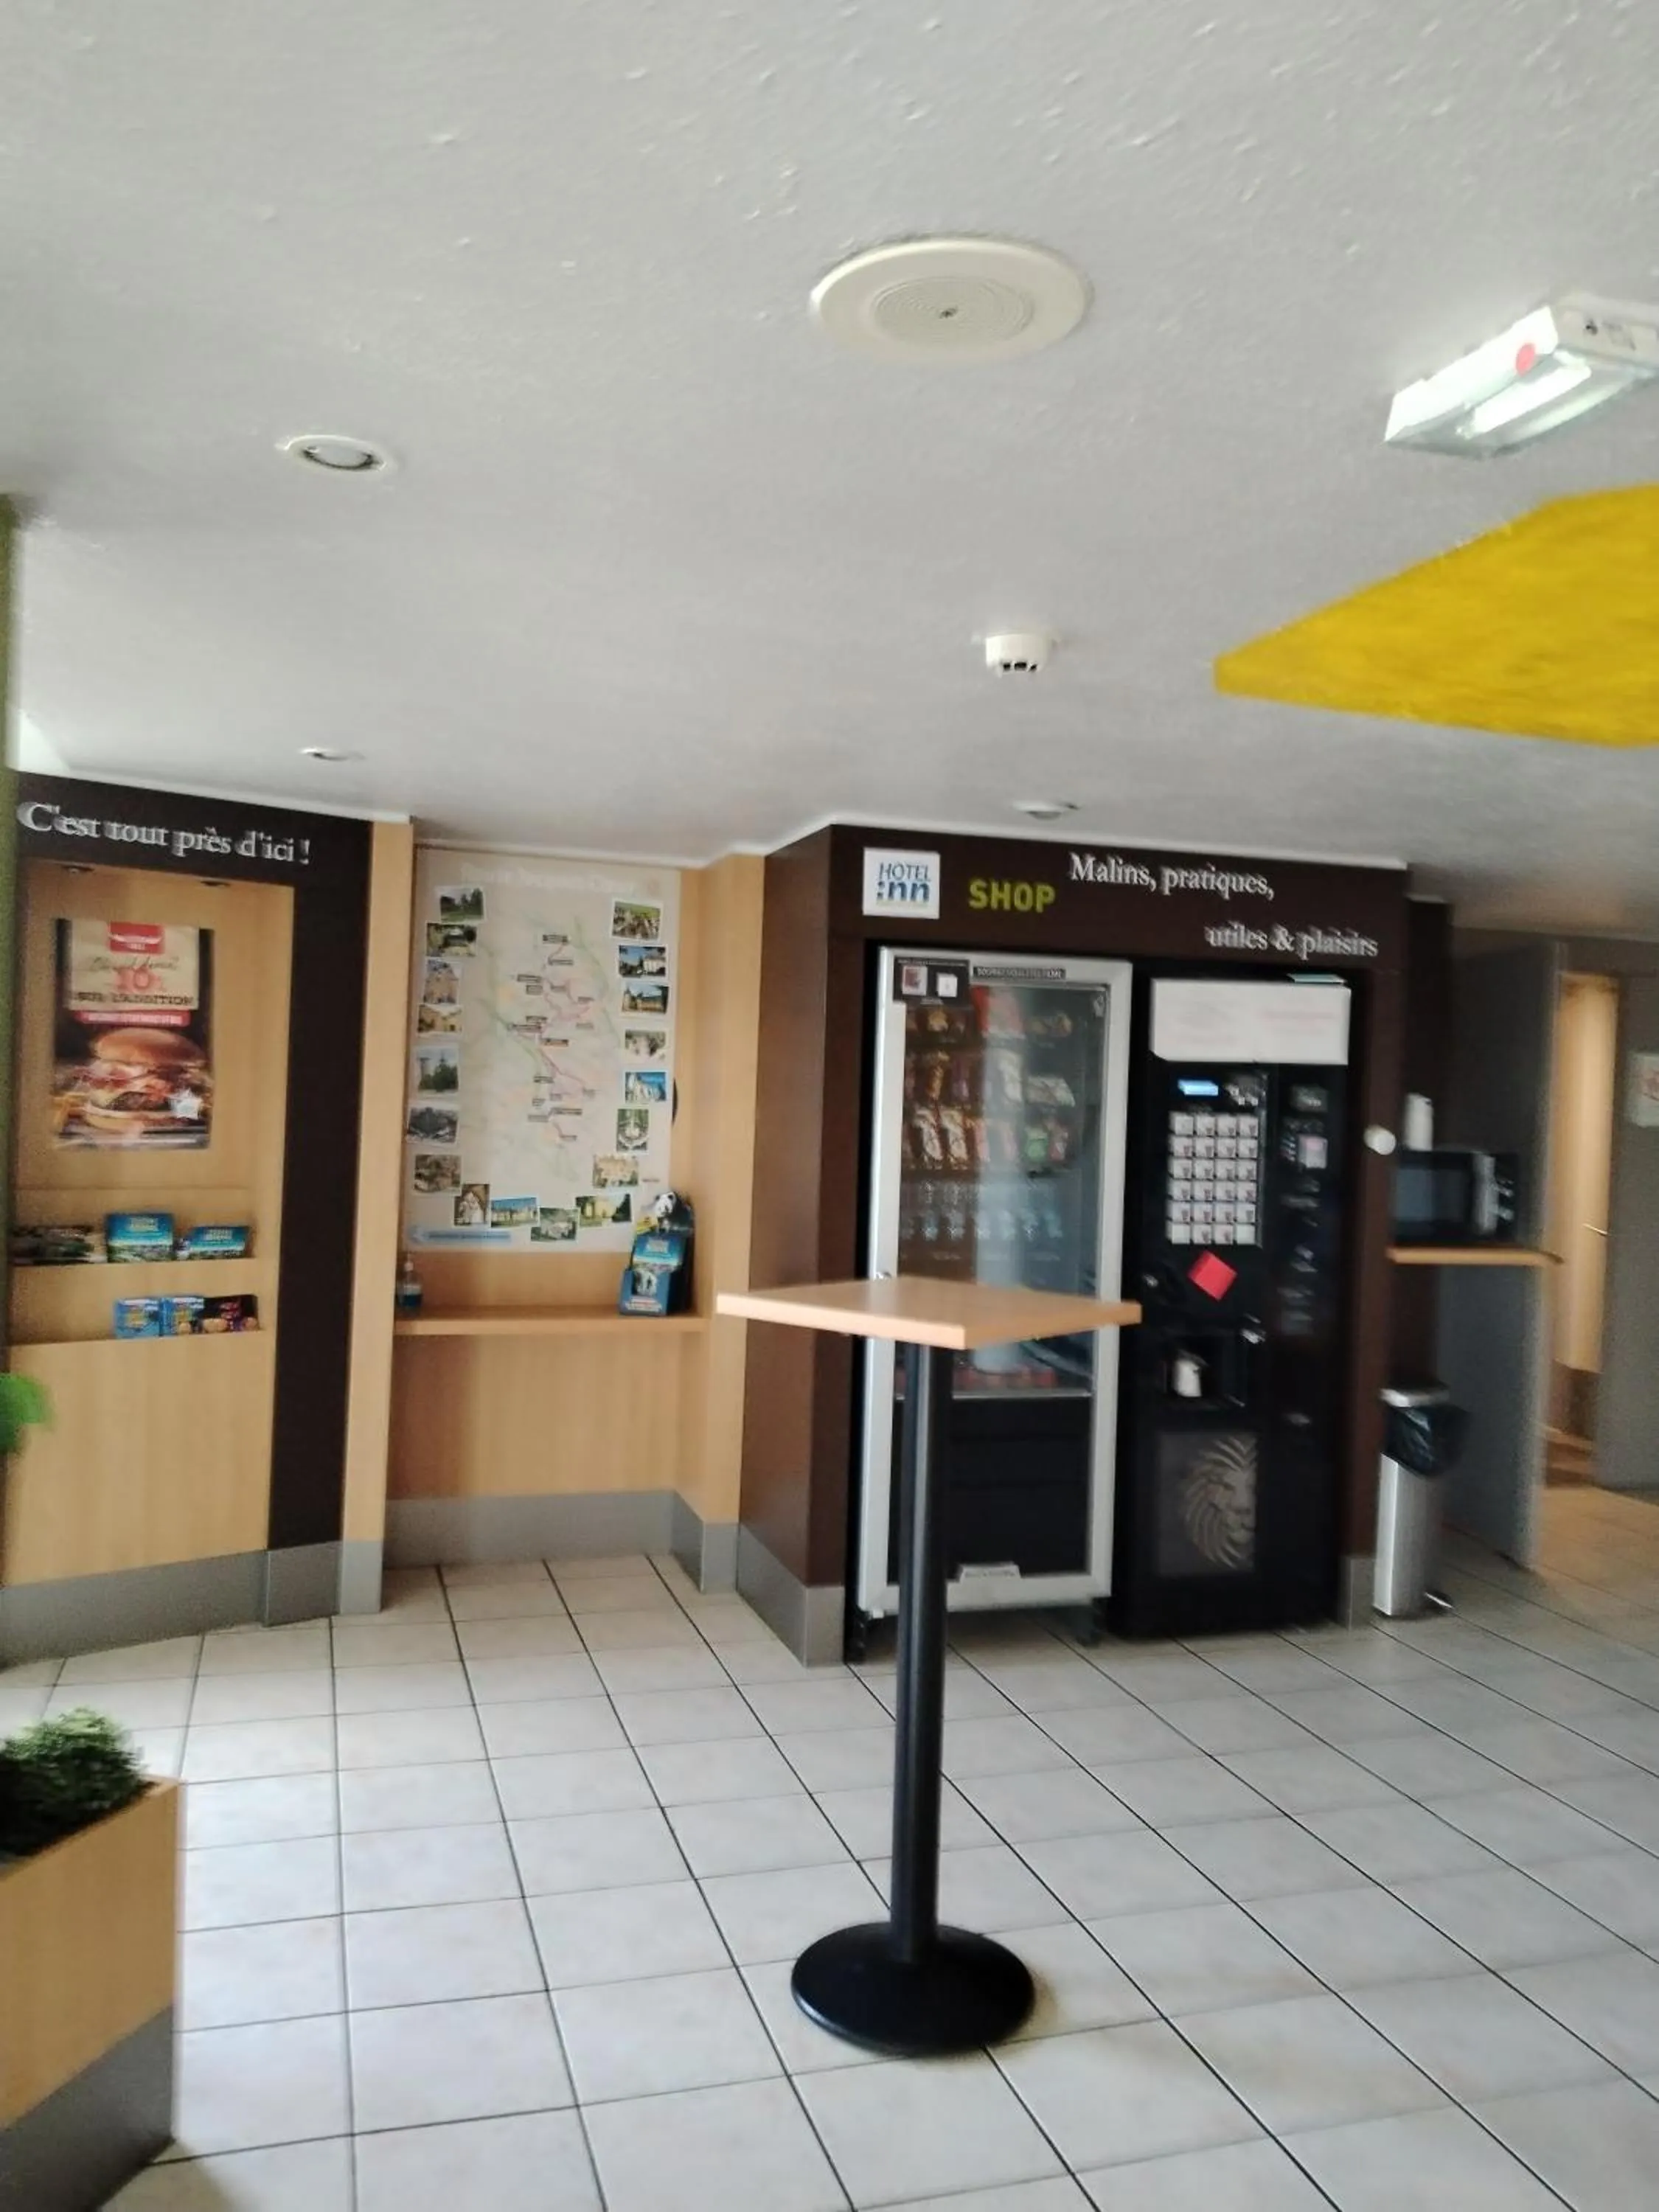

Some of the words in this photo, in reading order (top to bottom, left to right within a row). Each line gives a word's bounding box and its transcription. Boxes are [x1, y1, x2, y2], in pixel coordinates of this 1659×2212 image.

[16, 801, 101, 839] C'est
[104, 820, 168, 846] tout
[171, 826, 232, 858] près
[234, 830, 295, 863] d'ici
[297, 838, 311, 866] !
[879, 861, 931, 882] HOTEL
[1069, 851, 1158, 891] Malins,
[1160, 861, 1275, 901] pratiques,
[968, 877, 1057, 913] SHOP
[1204, 920, 1269, 951] utiles
[1270, 923, 1295, 951] &
[1296, 924, 1379, 961] plaisirs
